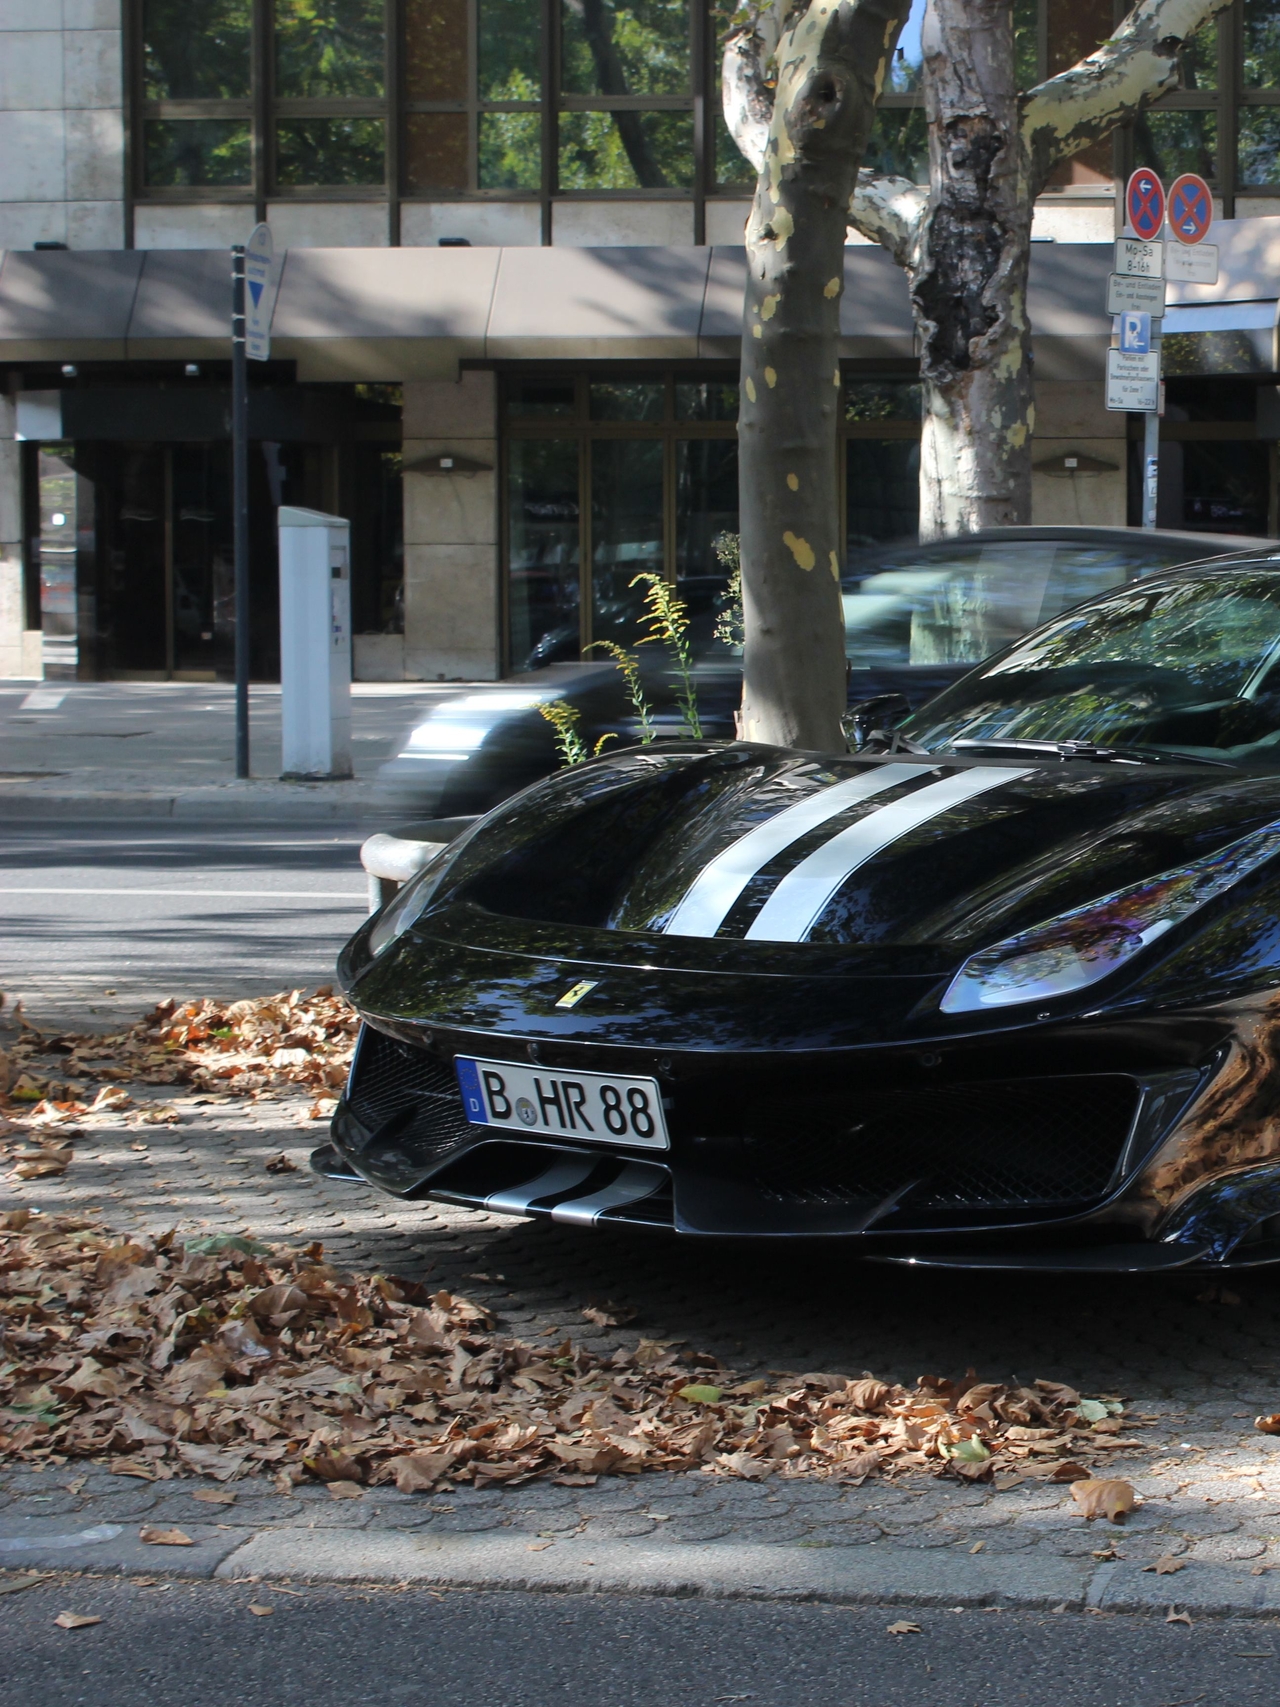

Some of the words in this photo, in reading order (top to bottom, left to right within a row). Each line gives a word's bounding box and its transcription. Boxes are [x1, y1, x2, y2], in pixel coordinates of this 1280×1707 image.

[1125, 244, 1153, 257] Mo-Sa
[1124, 315, 1142, 349] P
[470, 1098, 480, 1112] D
[481, 1068, 512, 1120] B
[533, 1075, 595, 1132] HR
[600, 1084, 655, 1139] 88
